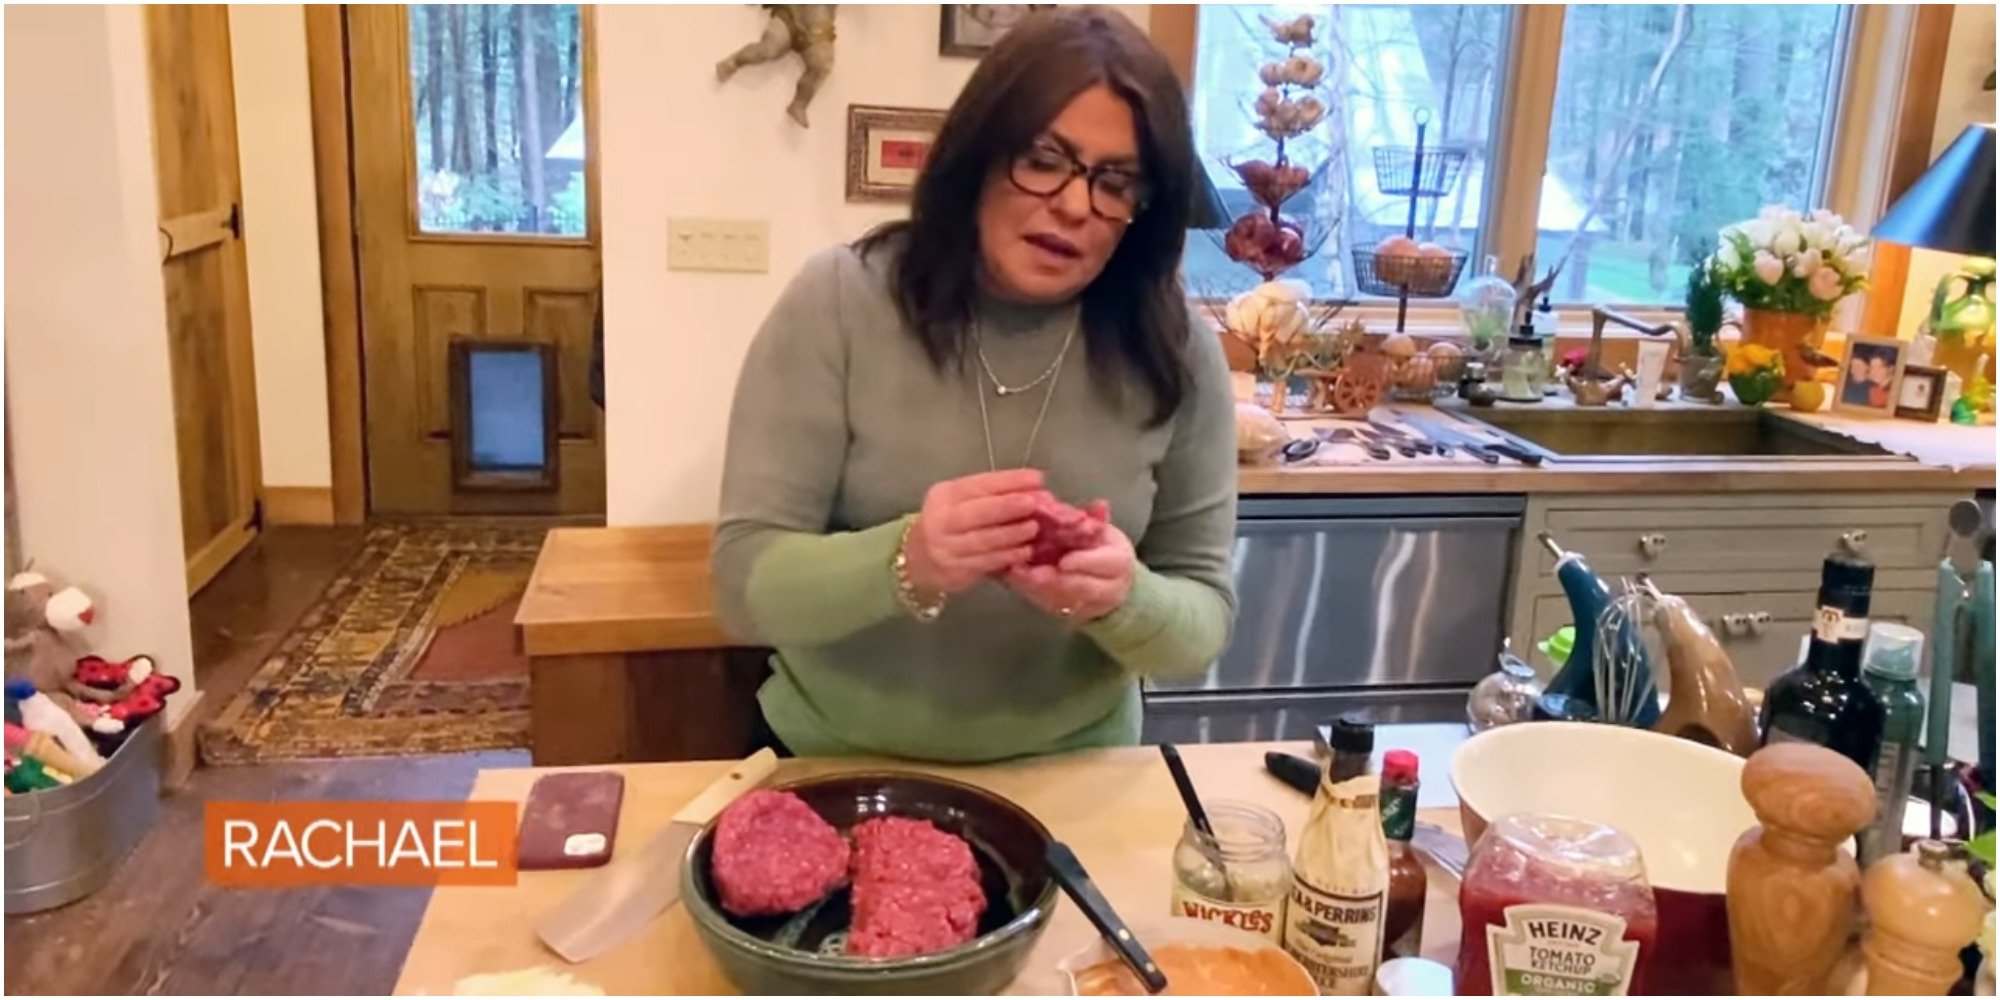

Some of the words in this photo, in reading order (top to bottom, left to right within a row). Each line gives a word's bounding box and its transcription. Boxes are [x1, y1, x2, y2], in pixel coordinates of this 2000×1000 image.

[1314, 900, 1378, 924] PERRINS
[1528, 920, 1602, 946] HEINZ
[1529, 946, 1596, 967] TOMATO
[1531, 959, 1592, 976] KETCHUP
[1521, 973, 1597, 994] ORGANIC
